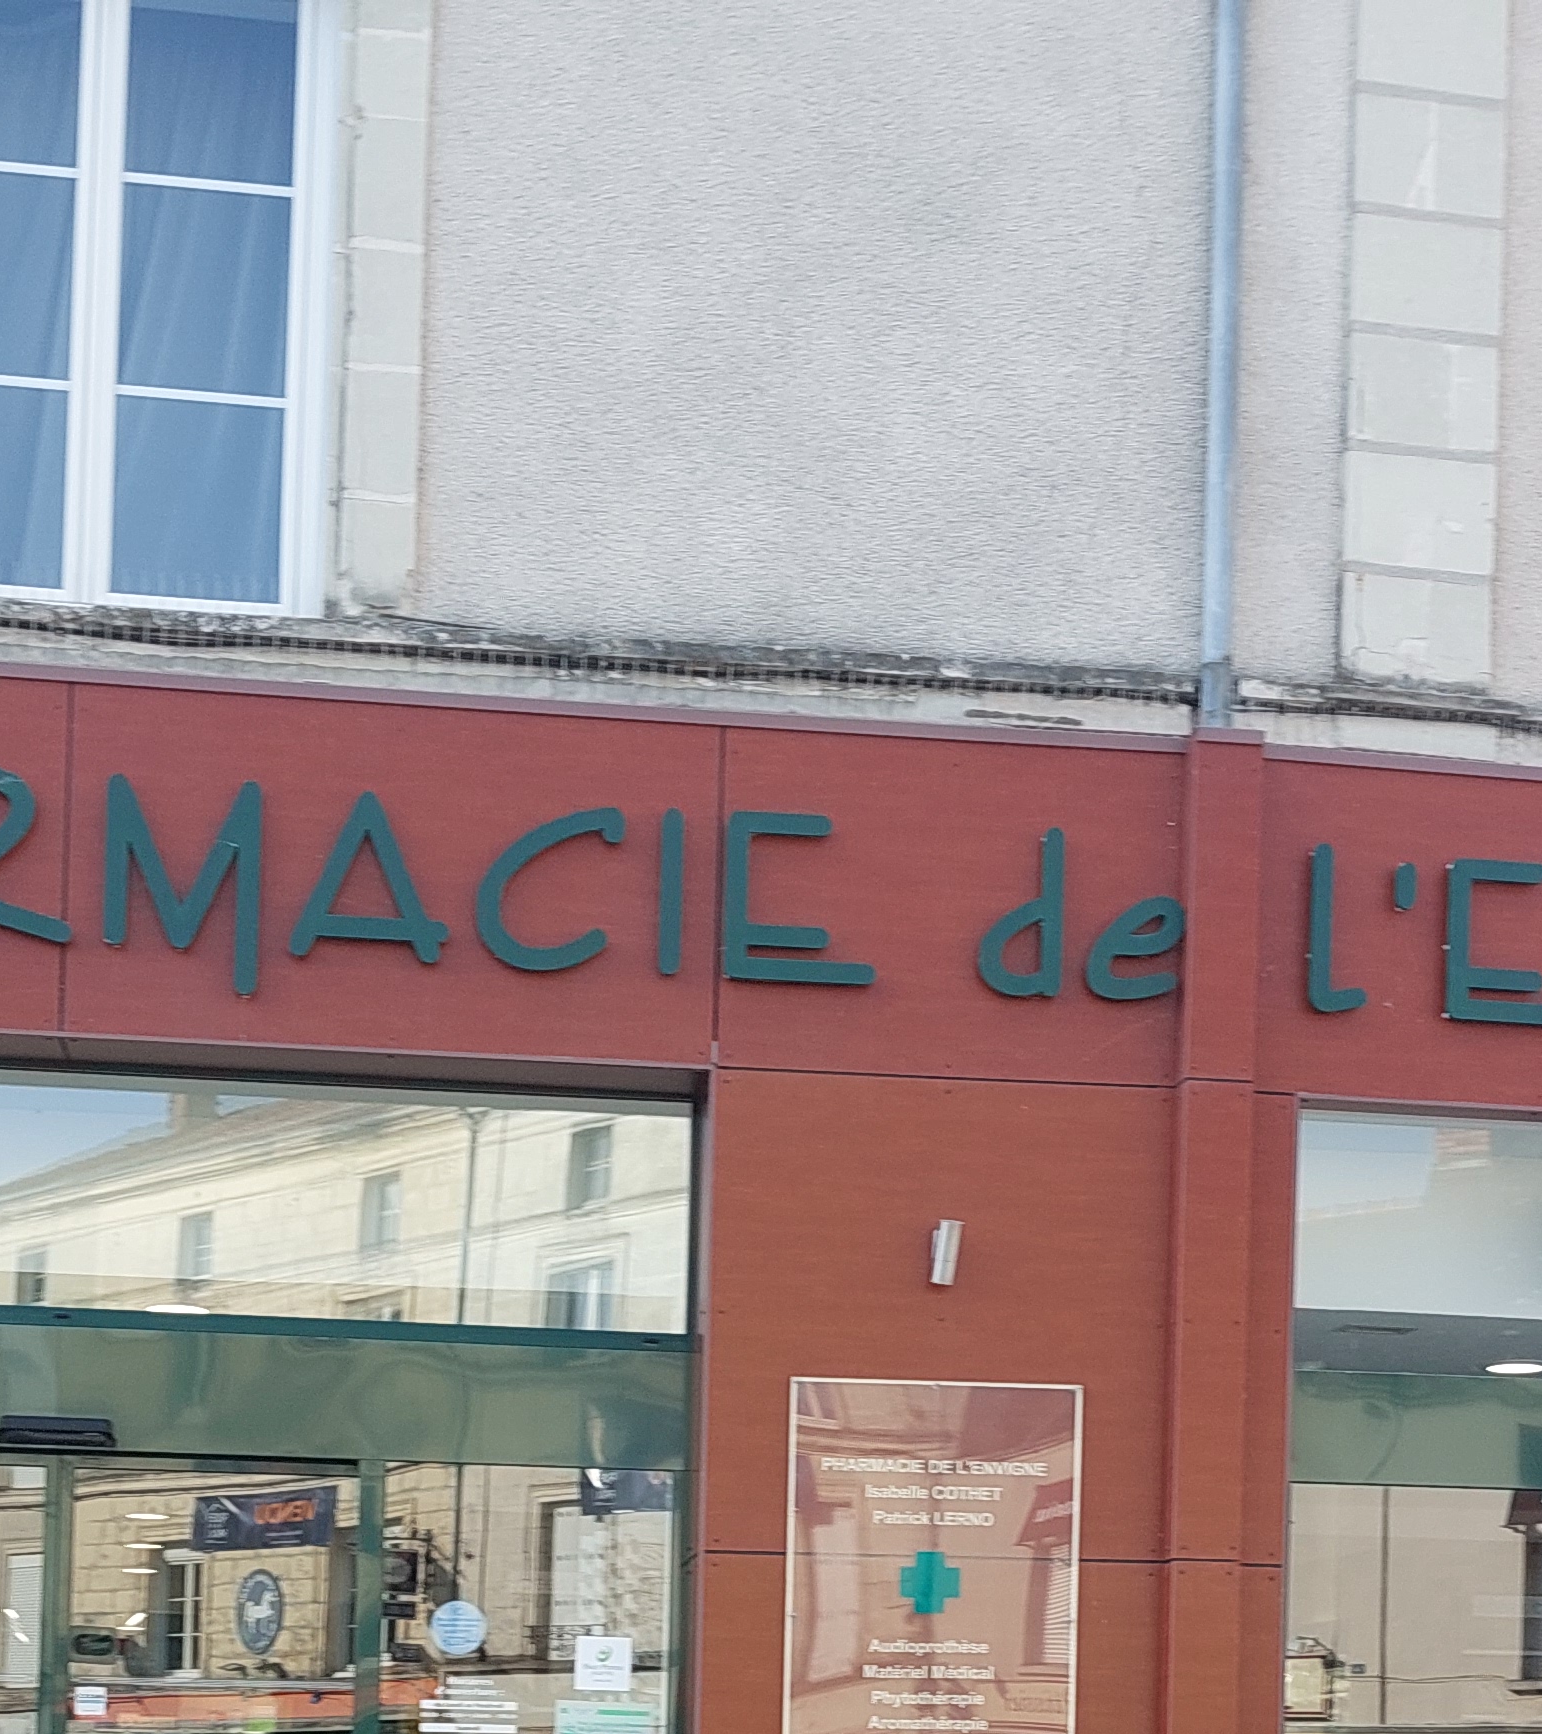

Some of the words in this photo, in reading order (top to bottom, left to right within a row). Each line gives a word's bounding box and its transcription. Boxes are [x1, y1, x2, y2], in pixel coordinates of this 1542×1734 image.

[978, 827, 1186, 1000] de
[820, 1458, 926, 1474] PHARMACIE
[928, 1460, 954, 1475] DE
[956, 1460, 1049, 1477] L'ENVIGNE
[864, 1484, 929, 1499] Isabelle
[872, 1510, 932, 1525] Patrick
[867, 1639, 990, 1656] Audioprothèse
[862, 1664, 929, 1679] Matériel
[930, 1665, 996, 1680] Médical
[870, 1691, 986, 1708] Phytothérapie
[867, 1715, 990, 1733] Aromathérapie
